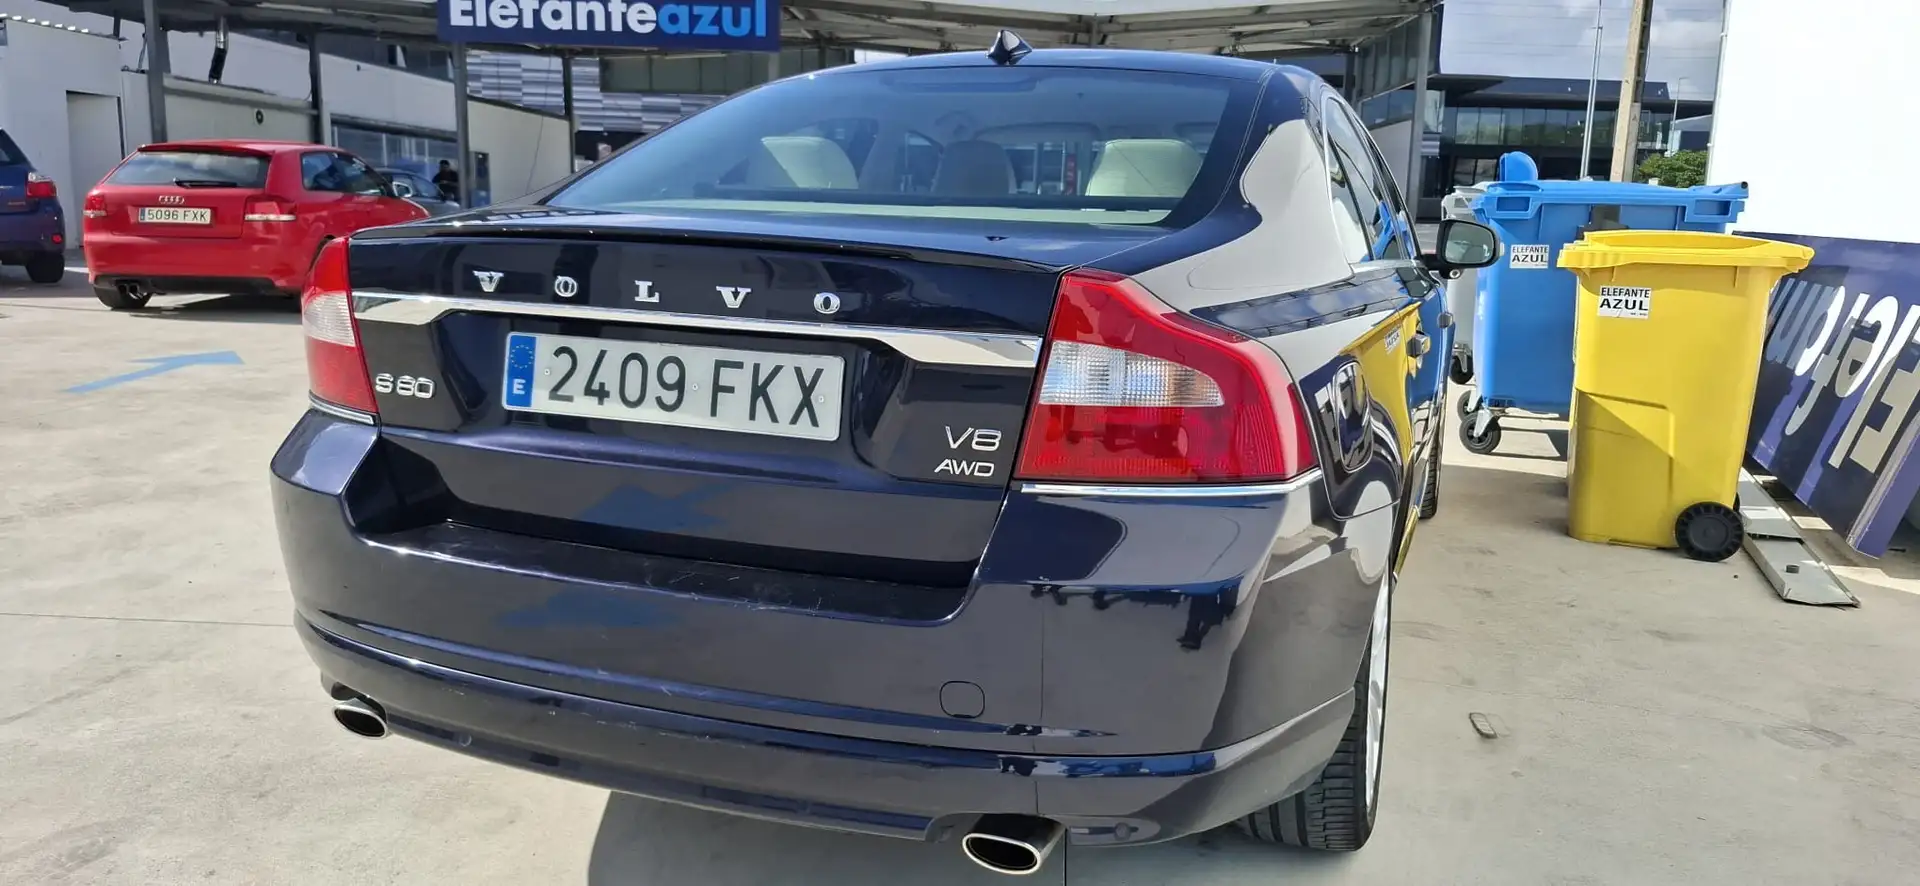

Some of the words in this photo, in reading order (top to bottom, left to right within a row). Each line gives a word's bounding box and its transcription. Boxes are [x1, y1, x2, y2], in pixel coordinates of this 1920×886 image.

[147, 209, 179, 220] 5096
[183, 210, 208, 222] FXK
[1511, 254, 1548, 263] AZUL
[1512, 246, 1549, 254] ELEFANTE
[473, 270, 841, 314] VOLVO
[1601, 287, 1650, 298] ELEFANTE
[1599, 298, 1649, 311] AZUL
[375, 373, 435, 399] S80
[512, 378, 526, 395] E
[548, 346, 687, 413] 2409
[710, 359, 825, 428] FKX
[945, 425, 1002, 452] V8
[934, 458, 995, 477] AWD
